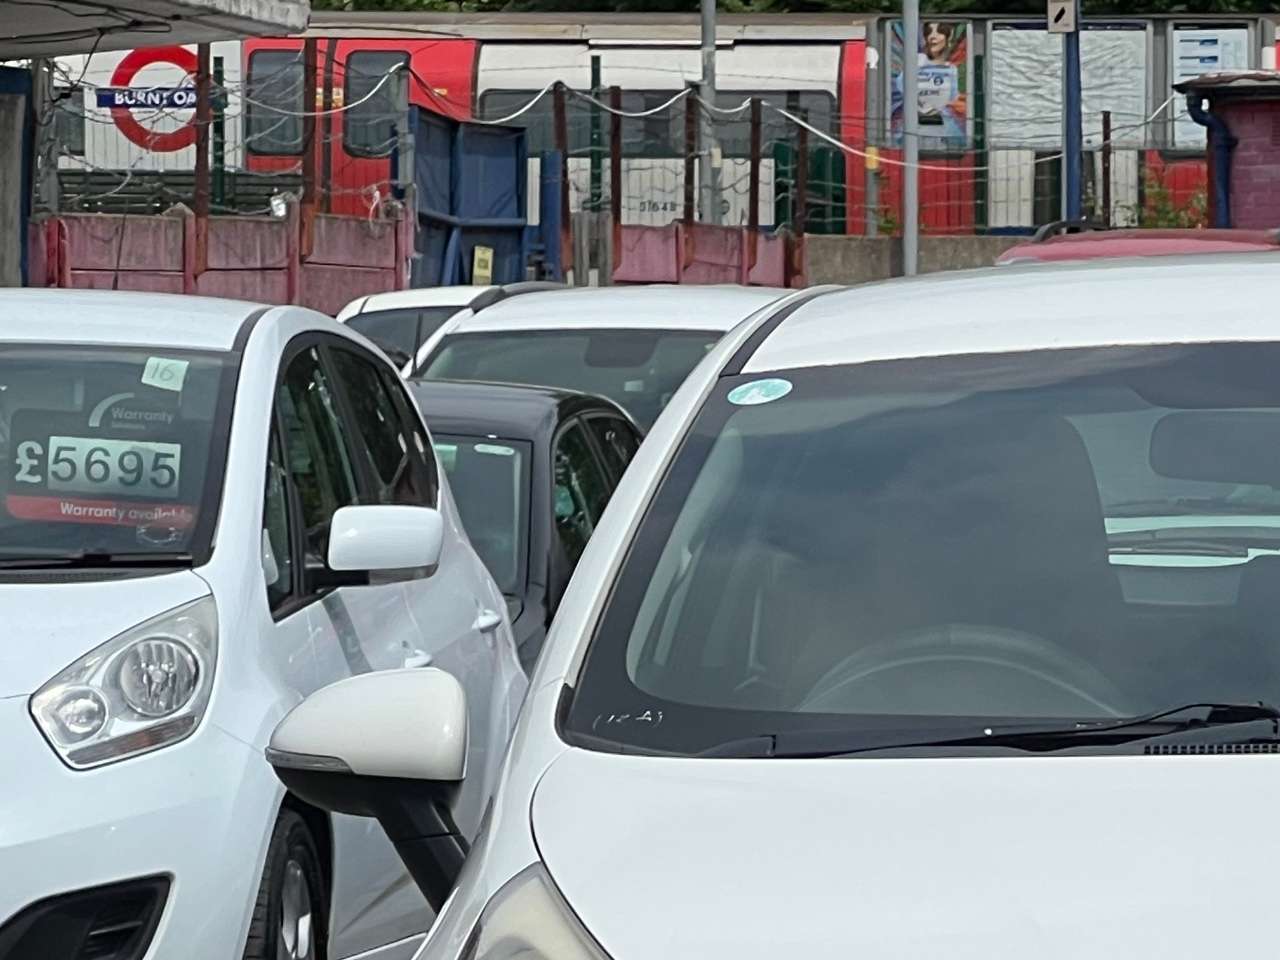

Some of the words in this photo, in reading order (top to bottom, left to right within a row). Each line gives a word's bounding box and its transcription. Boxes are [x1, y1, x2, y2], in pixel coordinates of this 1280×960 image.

[173, 90, 197, 105] OA
[111, 407, 175, 424] Warranty
[15, 440, 177, 489] £5695
[60, 502, 126, 521] Warranty
